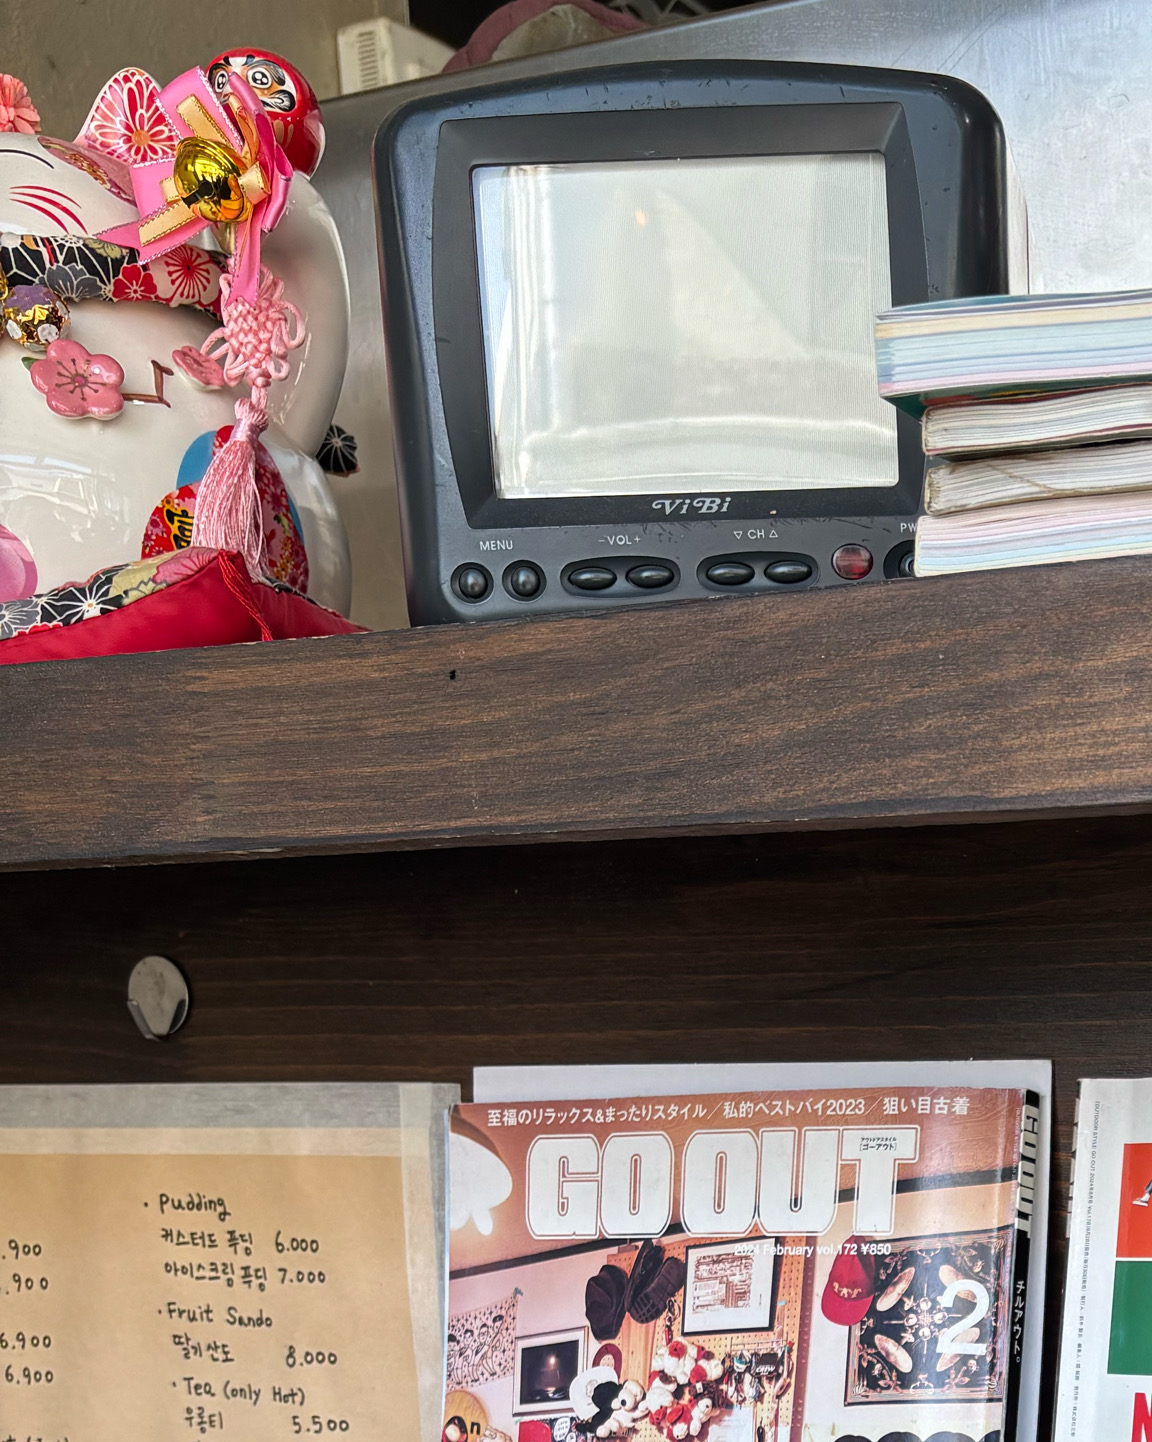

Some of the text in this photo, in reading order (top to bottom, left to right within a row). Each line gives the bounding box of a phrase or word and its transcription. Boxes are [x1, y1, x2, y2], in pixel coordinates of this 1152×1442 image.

[651, 496, 732, 515] ViBi
[479, 538, 514, 552] MENU
[747, 529, 765, 539] CH
[525, 1124, 921, 1240] GO OUT
[159, 1192, 231, 1222] Pudding
[161, 1228, 320, 1256] 커스터드 푸딩 6.000
[734, 1243, 892, 1258] 2024 February vol.172 ¥850
[240, 1266, 268, 1292] 푸딩
[277, 1267, 326, 1285] 7.000
[167, 1302, 273, 1328] Fruit Sando
[936, 1279, 990, 1355] 2
[0, 1331, 51, 1350] 6.900
[285, 1344, 338, 1368] 8.000
[5, 1363, 54, 1386] 6.900
[183, 1377, 306, 1407] Tea (only Hot)
[184, 1406, 350, 1434] 우롱티 5.500
